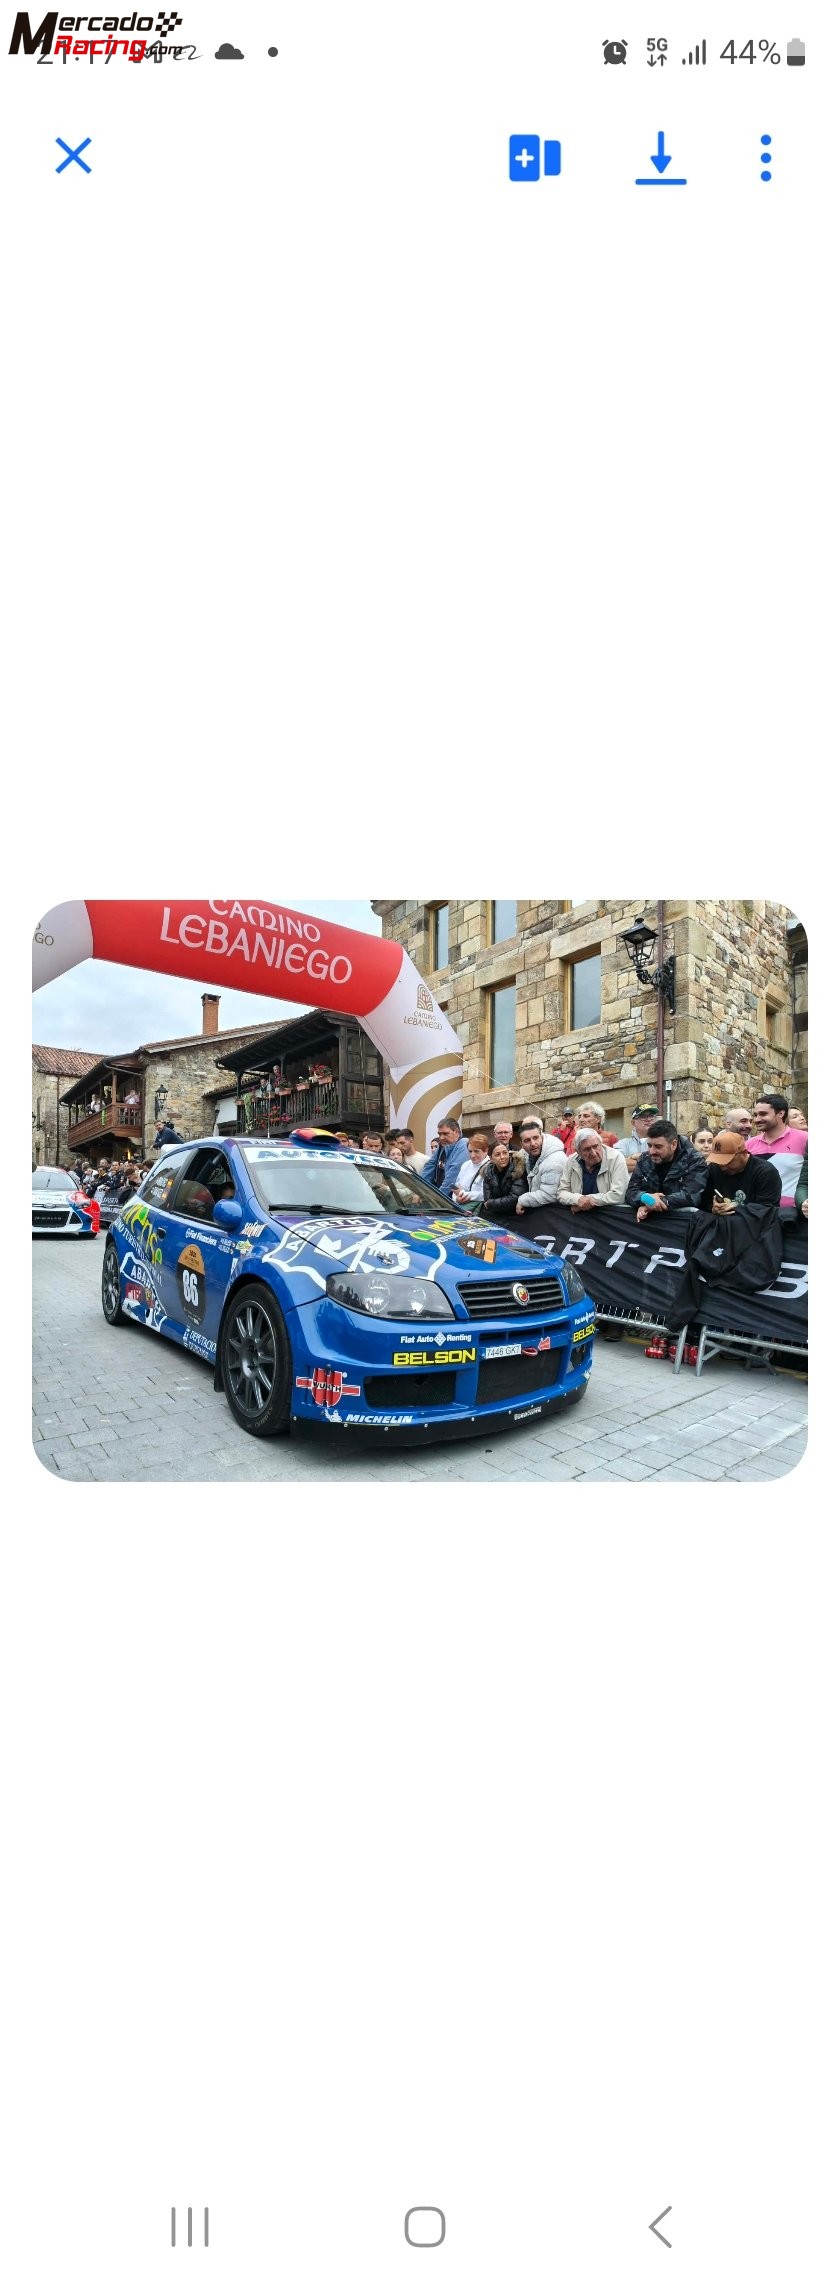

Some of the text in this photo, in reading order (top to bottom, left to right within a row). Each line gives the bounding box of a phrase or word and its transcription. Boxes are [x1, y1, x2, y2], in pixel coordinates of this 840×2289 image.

[646, 38, 668, 51] 5G
[720, 39, 781, 65] 44%
[208, 900, 321, 943] CAMINO
[159, 906, 352, 984] LEBANIEGO
[403, 1016, 442, 1031] LEBANIEGO
[285, 1219, 364, 1251] ABARTH
[182, 1269, 199, 1307] 86
[400, 1333, 472, 1344] Fiat Auto Renting
[393, 1347, 476, 1366] BELSON
[345, 1413, 413, 1424] MICHELIN
